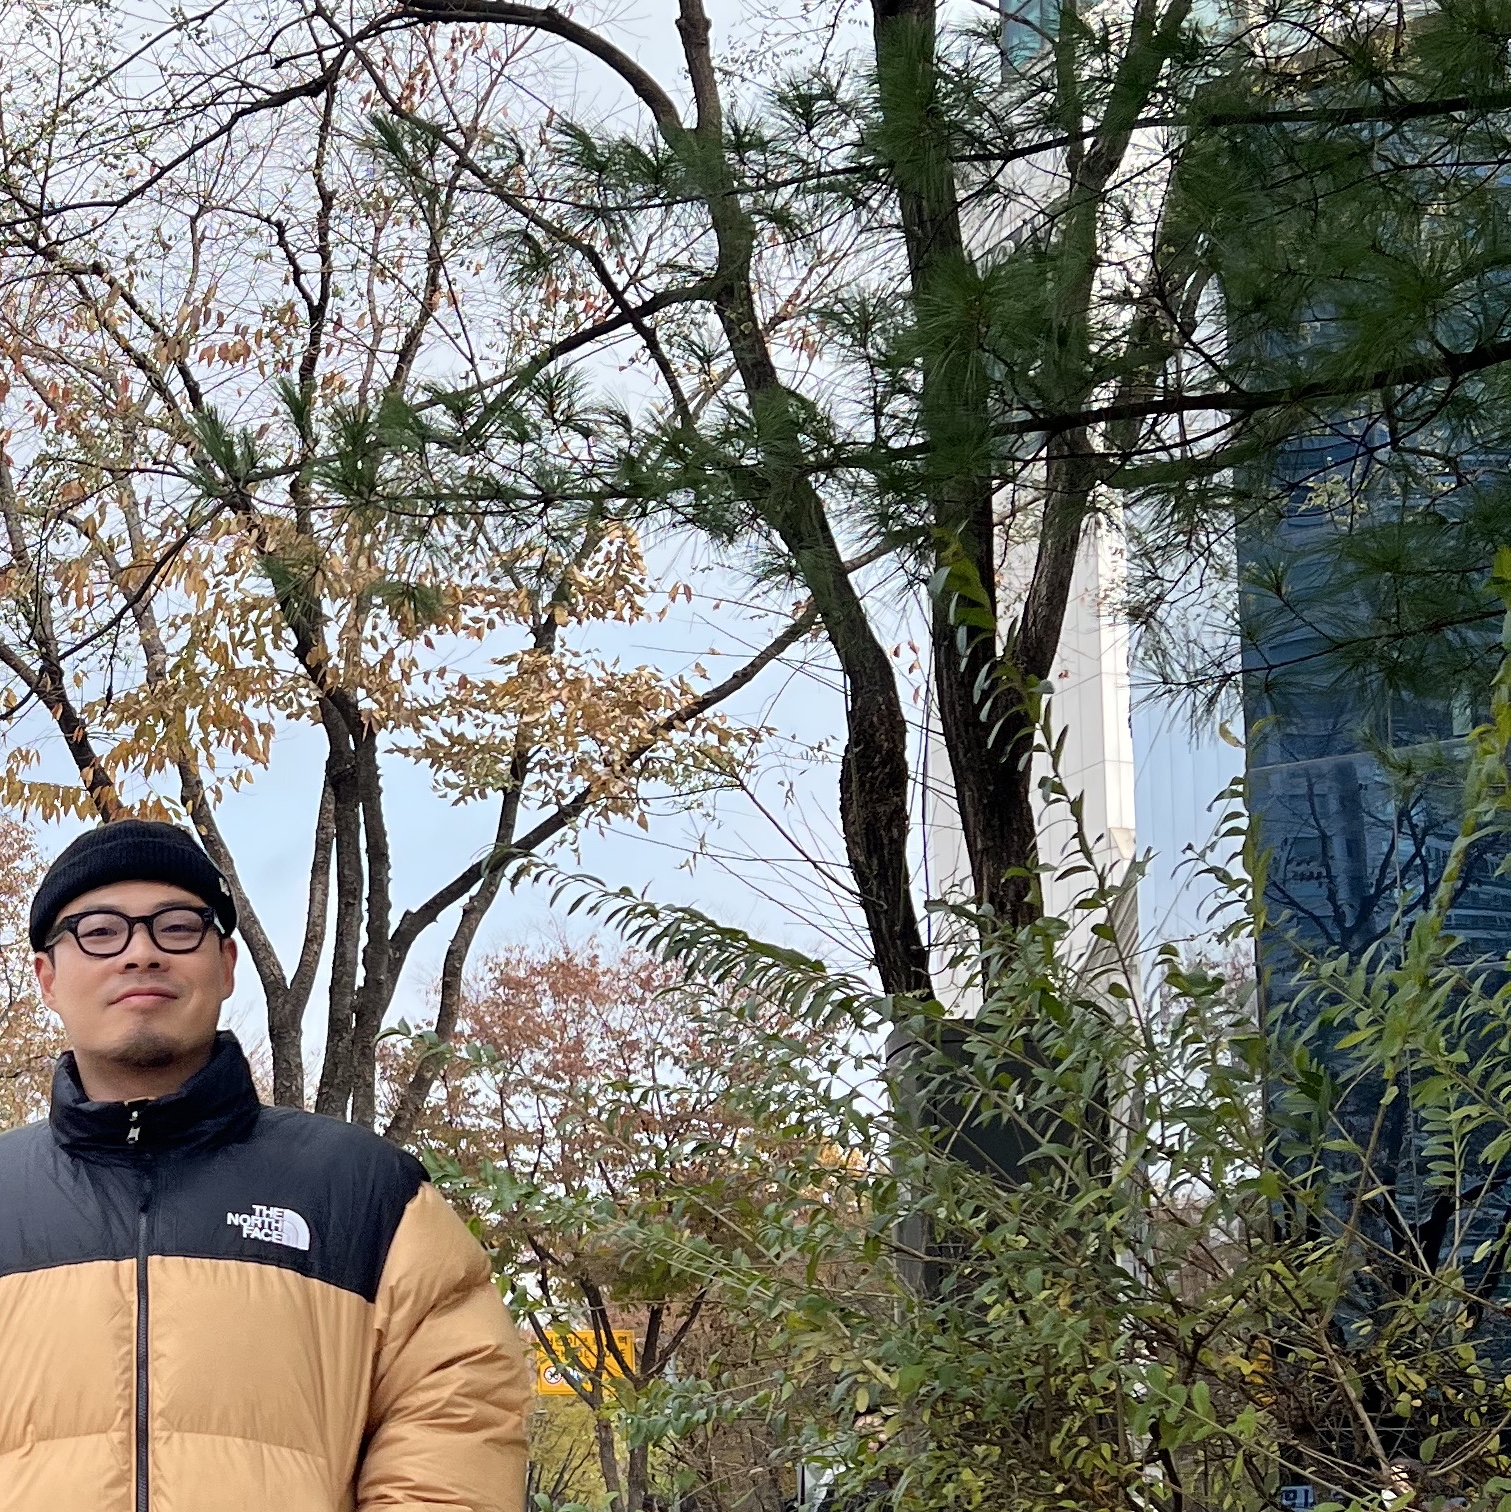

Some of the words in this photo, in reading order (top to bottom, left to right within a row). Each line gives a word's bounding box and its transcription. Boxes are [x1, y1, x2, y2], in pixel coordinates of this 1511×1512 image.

[251, 1204, 285, 1219] THE
[226, 1212, 284, 1232] NORTH
[242, 1226, 283, 1242] FACE
